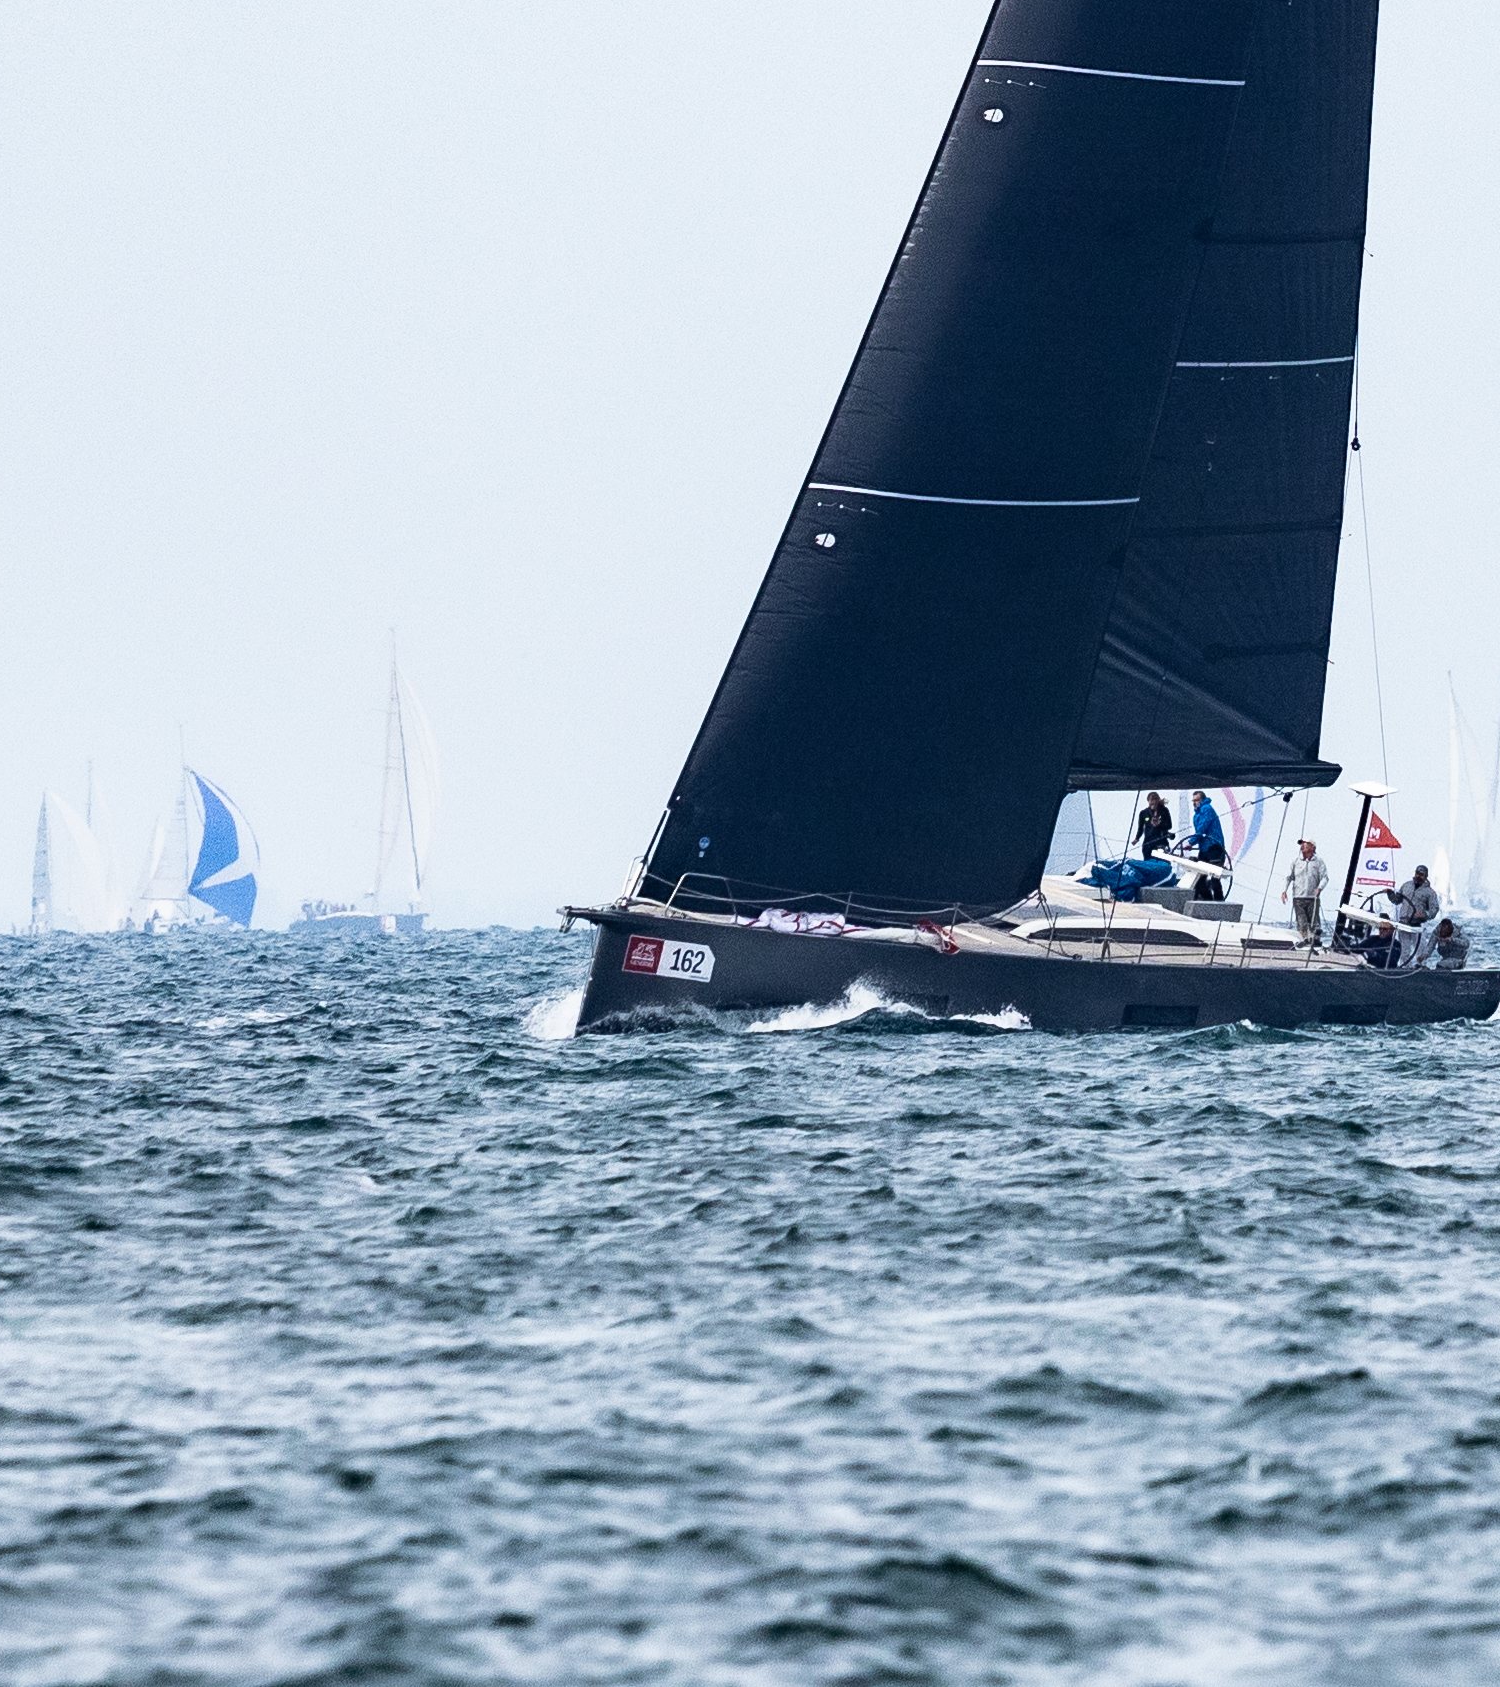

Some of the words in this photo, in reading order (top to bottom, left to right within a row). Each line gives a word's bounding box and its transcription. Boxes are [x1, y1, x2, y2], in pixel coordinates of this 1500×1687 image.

[1369, 826, 1381, 839] M
[1365, 859, 1389, 872] GLS
[669, 947, 706, 974] 162
